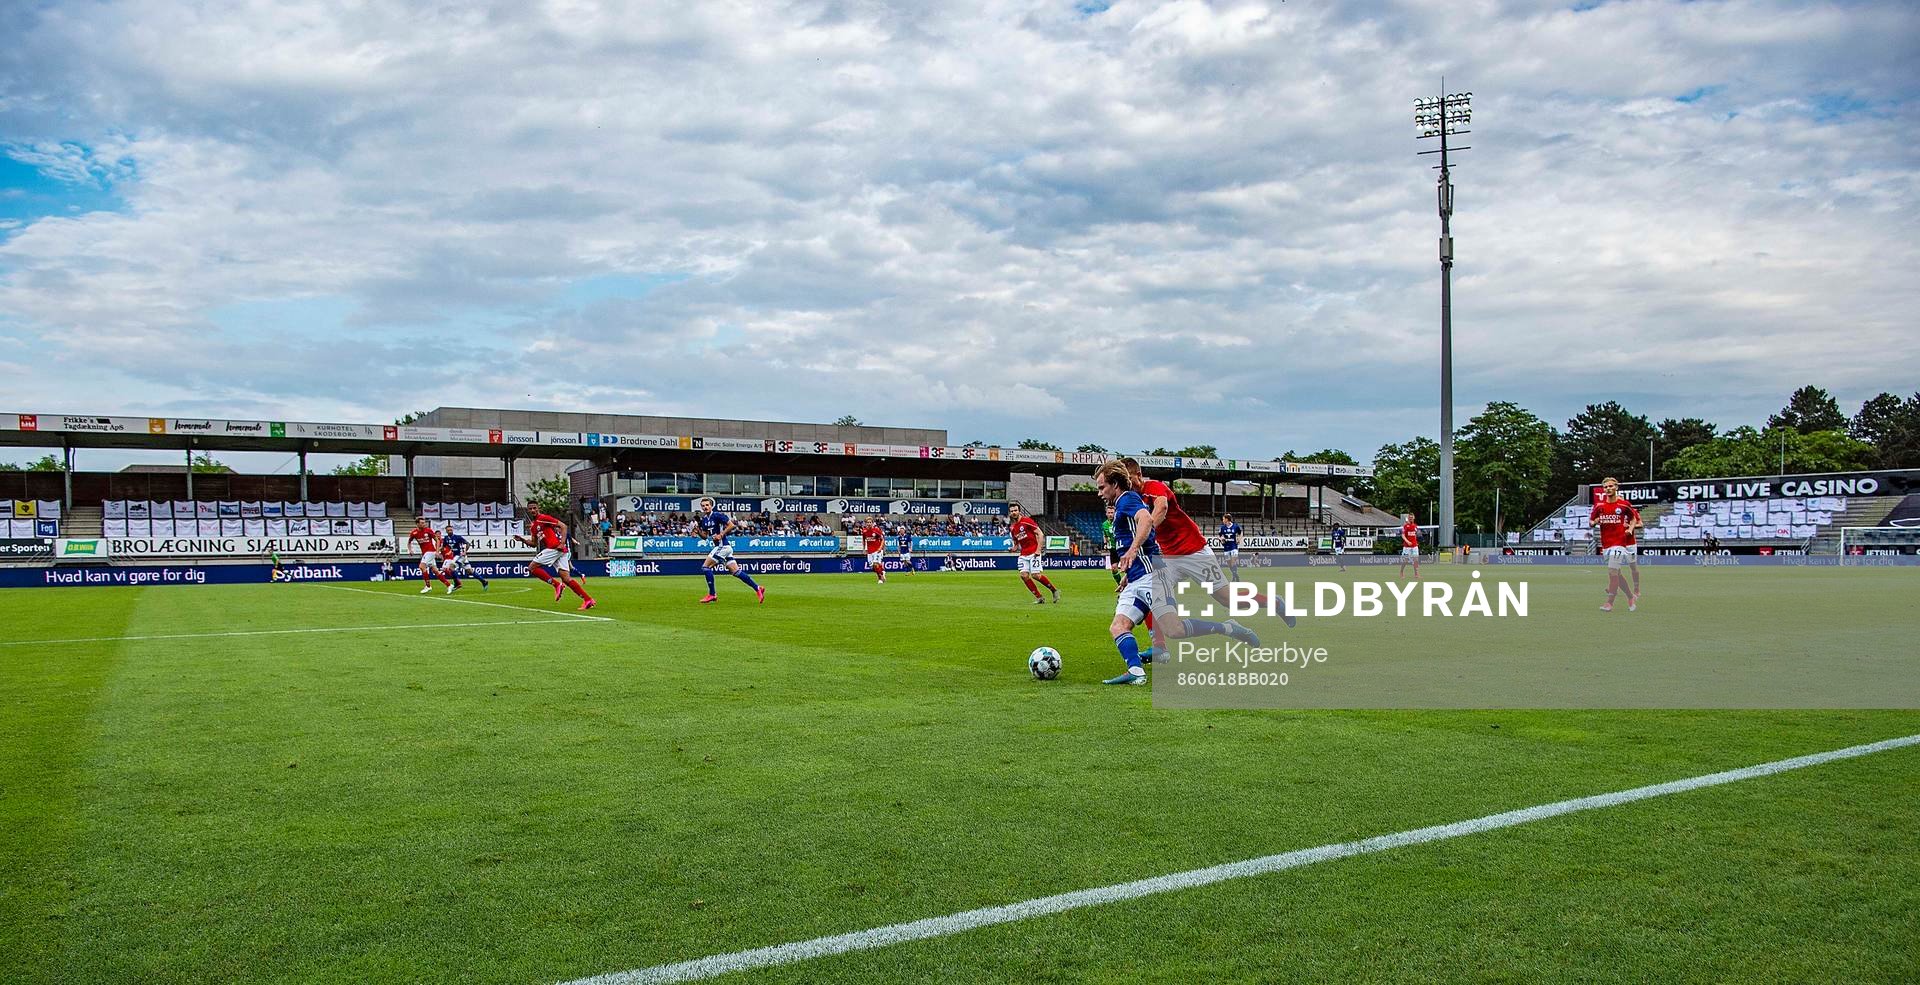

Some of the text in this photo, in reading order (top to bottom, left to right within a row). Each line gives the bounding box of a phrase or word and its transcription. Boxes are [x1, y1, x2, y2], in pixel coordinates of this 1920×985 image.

[620, 436, 678, 446] Brødrene Dahl
[778, 441, 793, 452] 3F
[813, 442, 828, 453] 3F
[931, 447, 945, 458] 3F
[962, 448, 975, 459] 3F
[1072, 453, 1108, 464] REPLAY
[1677, 478, 1879, 500] SPIL LIVE CASINO
[643, 500, 680, 511] carl ras
[717, 501, 752, 512] carl ras
[785, 501, 818, 512] carl ras
[849, 502, 881, 513] carl ras
[911, 503, 940, 514] carl ras
[972, 504, 1000, 515] carl ras
[41, 524, 53, 534] Fog
[112, 539, 360, 553] BROLÆGNING SJÆLLAND APS
[486, 539, 498, 549] 41
[504, 538, 516, 549] 10
[655, 538, 684, 547] carl ras
[760, 538, 786, 547] carl ras
[809, 538, 835, 547] carl ras
[928, 538, 940, 546] carl
[971, 538, 982, 546] carl
[11, 544, 50, 554] Sporten
[864, 561, 904, 570] LGBY
[955, 558, 997, 570] Sydbank
[1049, 558, 1063, 567] kan
[1063, 558, 1071, 567] vi
[1071, 558, 1088, 569] gøre
[1088, 557, 1099, 566] for
[1308, 555, 1337, 567] Sydbank
[1497, 555, 1533, 565] Sydbank
[495, 563, 511, 575] for
[513, 563, 530, 577] dig
[750, 561, 760, 571] vi
[760, 562, 781, 574] gøre
[782, 561, 796, 571] for
[796, 560, 811, 573] dig
[45, 567, 206, 584] Hvad kan vi gøre for dig
[1201, 565, 1222, 582] 26
